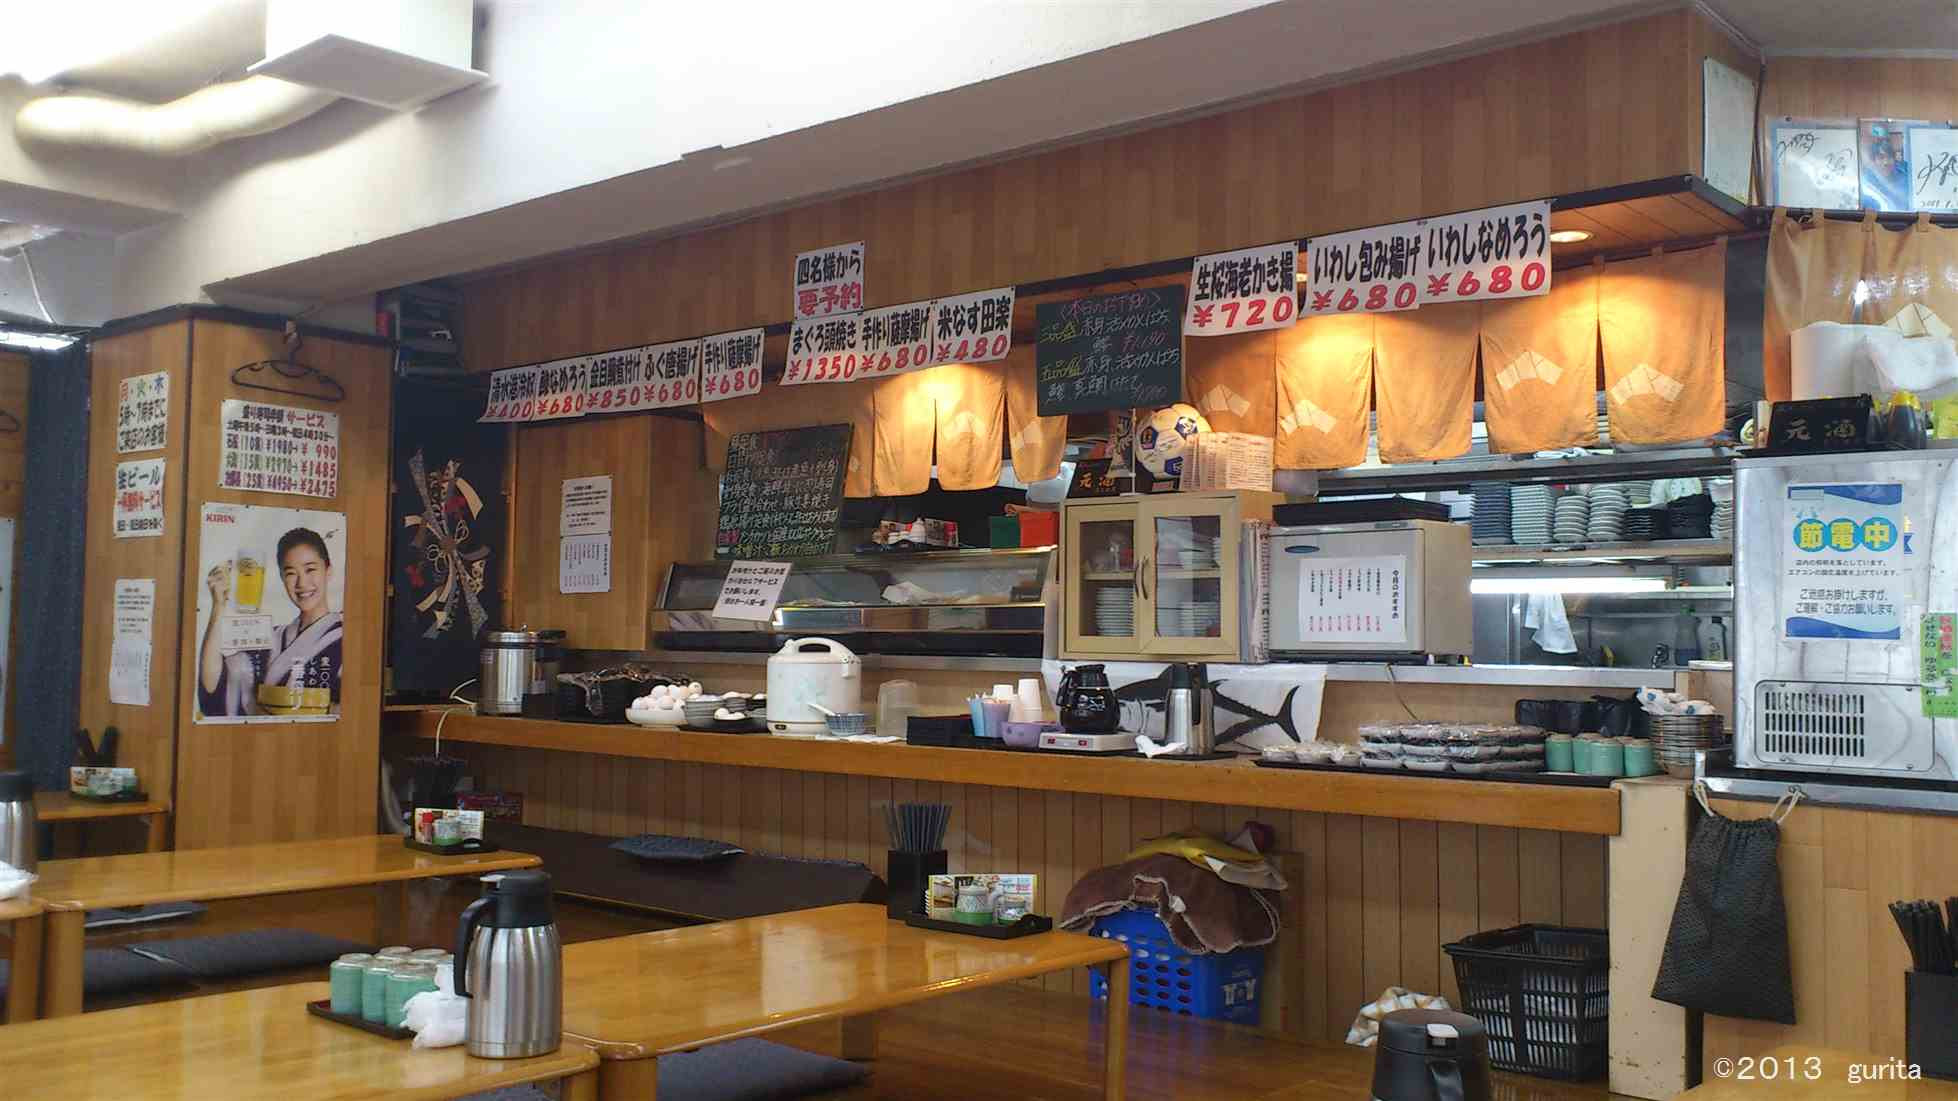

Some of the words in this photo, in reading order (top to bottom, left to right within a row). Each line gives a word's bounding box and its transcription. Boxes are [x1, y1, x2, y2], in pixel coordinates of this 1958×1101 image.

[1427, 213, 1546, 268] いわしなめろう
[798, 250, 861, 285] 四名様から
[1313, 236, 1422, 284] いわし包み揚げ
[1195, 251, 1294, 301] 生桜海老かき揚
[1426, 262, 1546, 297] ¥680
[798, 281, 861, 316] 要予約
[1193, 295, 1293, 328] ¥720
[1311, 282, 1417, 312] ¥680
[862, 306, 930, 350] 手作り薩摩揚げ
[937, 296, 1011, 340] 米なす田楽
[792, 320, 857, 354] まぐろ頭焼き
[936, 334, 1008, 362] ¥480
[645, 345, 698, 380] ふぐ唐揚げ
[705, 334, 761, 373] 手作り薩摩揚げ
[788, 353, 855, 381] ¥1350
[861, 344, 928, 372] ¥680
[590, 355, 641, 388] 金目鯛煮付け
[705, 368, 759, 395] ¥680
[536, 393, 584, 415] ¥680
[586, 386, 640, 409] ¥850
[644, 378, 695, 401] ¥680
[287, 410, 325, 428] サービス
[118, 465, 161, 490] 生ビール
[301, 460, 336, 479] ¥1485
[301, 479, 335, 497] ¥2475
[205, 512, 235, 524] KIRIN
[1799, 521, 1890, 548] 節電中
